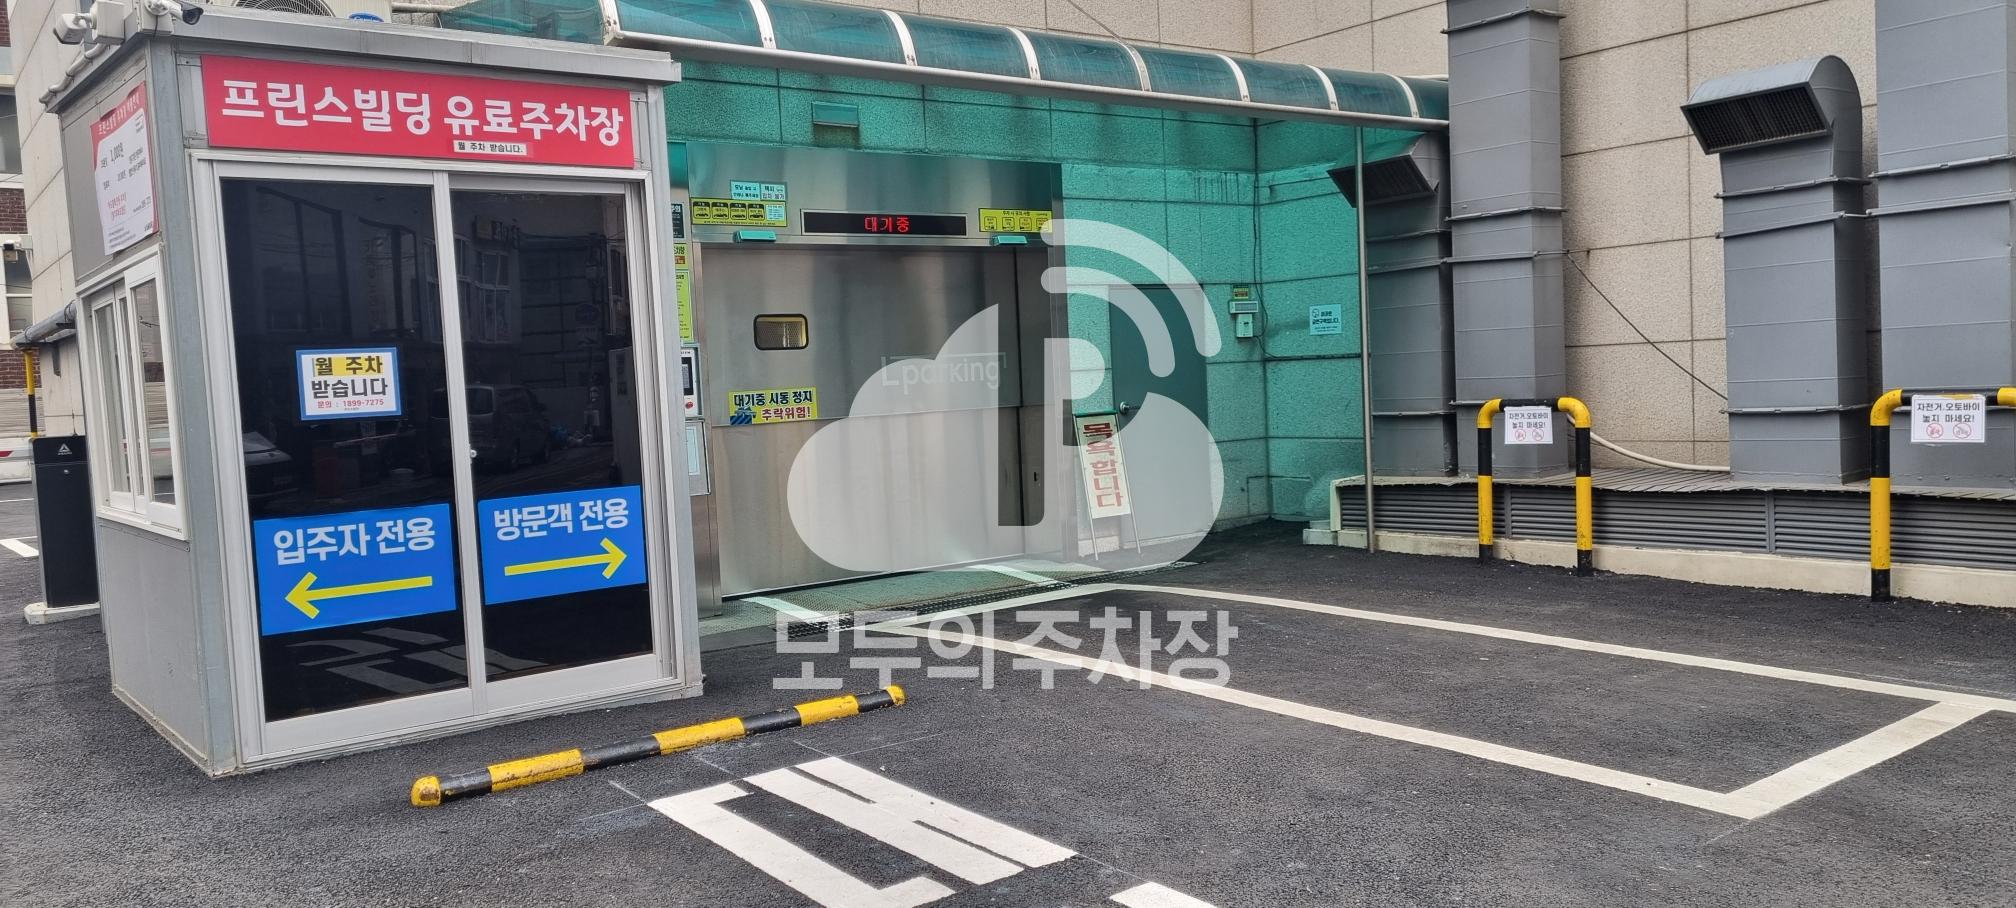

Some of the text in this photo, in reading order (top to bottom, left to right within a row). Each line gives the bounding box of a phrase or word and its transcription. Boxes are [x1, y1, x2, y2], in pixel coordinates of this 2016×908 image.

[221, 78, 625, 146] 프린스빌딩 유료주차장
[458, 141, 523, 153] 월 주차 받습니다.
[864, 216, 910, 233] 대기중
[315, 355, 383, 376] 월 주차
[311, 377, 388, 399] 받습니다
[317, 400, 332, 409] 문의
[343, 399, 384, 407] 1899-7275
[733, 390, 813, 407] 대기중 시동 정지
[762, 406, 811, 421] 추락위험!
[1945, 414, 1975, 423] 마세요!
[1082, 422, 1124, 508] 목욕합니다
[493, 496, 630, 541] 방문객 전용
[273, 516, 436, 566] 입주자 전용
